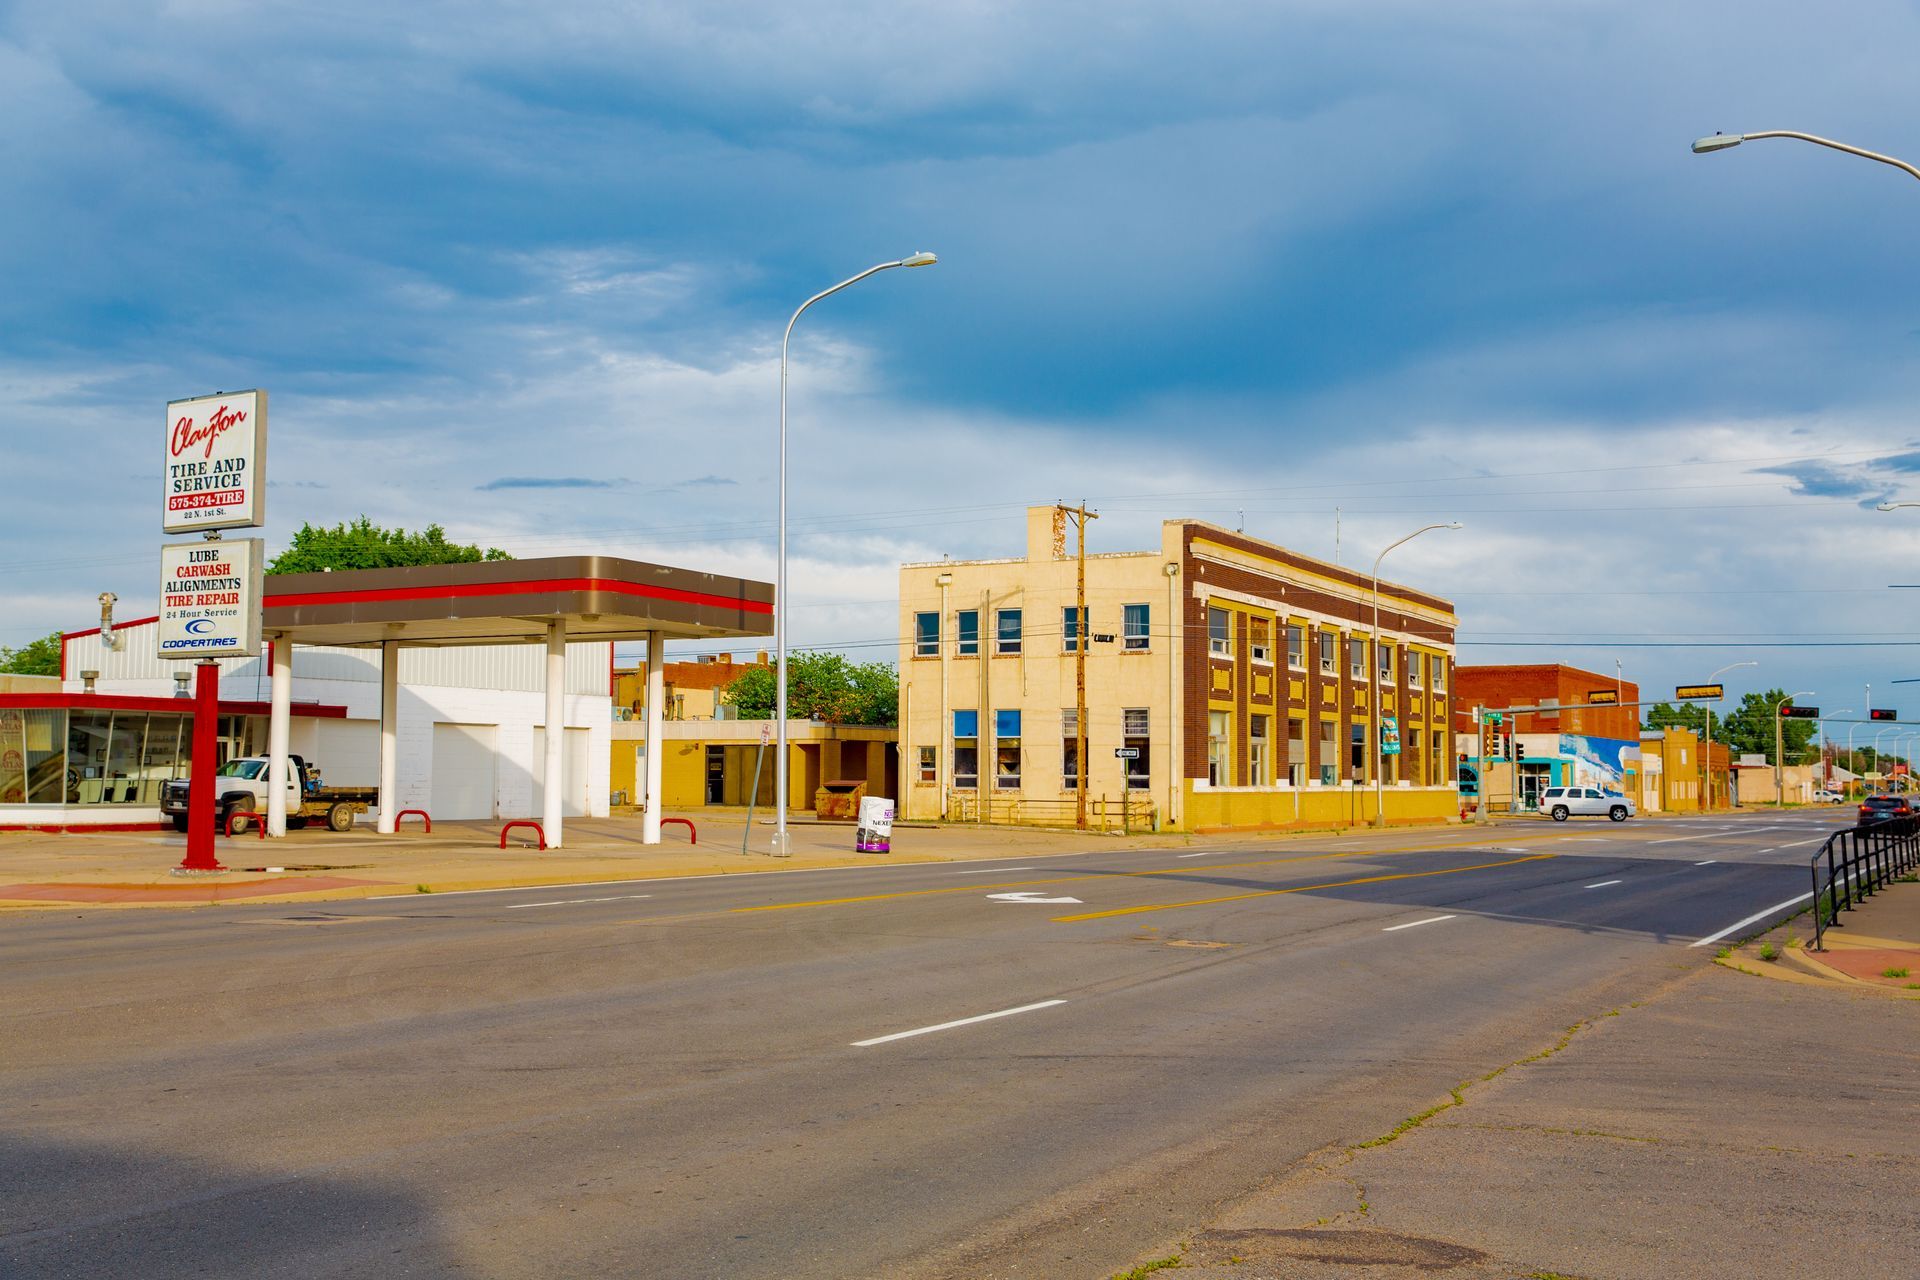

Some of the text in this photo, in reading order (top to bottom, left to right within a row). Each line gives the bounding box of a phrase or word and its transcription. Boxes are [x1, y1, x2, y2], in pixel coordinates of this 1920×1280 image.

[171, 405, 247, 458] Clayton
[171, 458, 245, 478] TIRE AND
[173, 473, 241, 493] SERVICE
[170, 491, 243, 509] 575-374-TIRE
[184, 508, 226, 519] 22 N. 1st St.
[190, 550, 218, 562] LUBE
[176, 563, 231, 578] CARWASH
[165, 577, 241, 593] ALIGNMENTS
[165, 592, 239, 607] TIRE REPAIR
[180, 610, 201, 618] Hour
[204, 608, 237, 616] Service
[163, 638, 237, 648] COOPERTIRES
